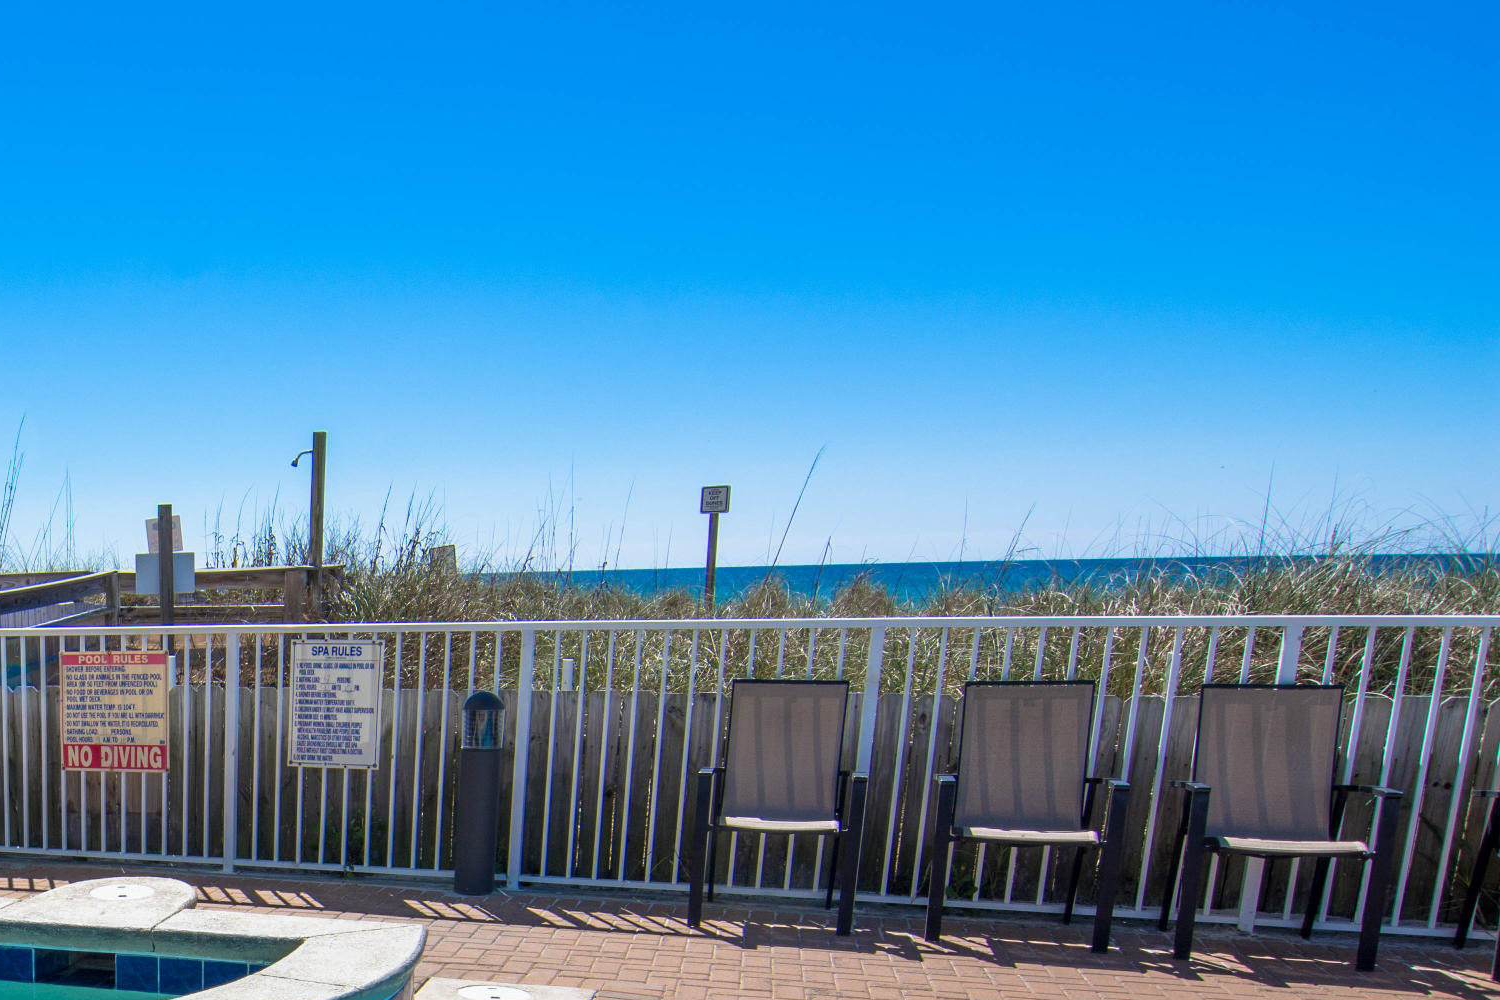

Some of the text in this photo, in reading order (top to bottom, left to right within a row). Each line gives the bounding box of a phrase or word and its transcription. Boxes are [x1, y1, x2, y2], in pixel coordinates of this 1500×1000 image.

[312, 646, 362, 656] SPA RULES
[78, 655, 148, 664] POOL RULES
[68, 745, 162, 768] NO DIVING
